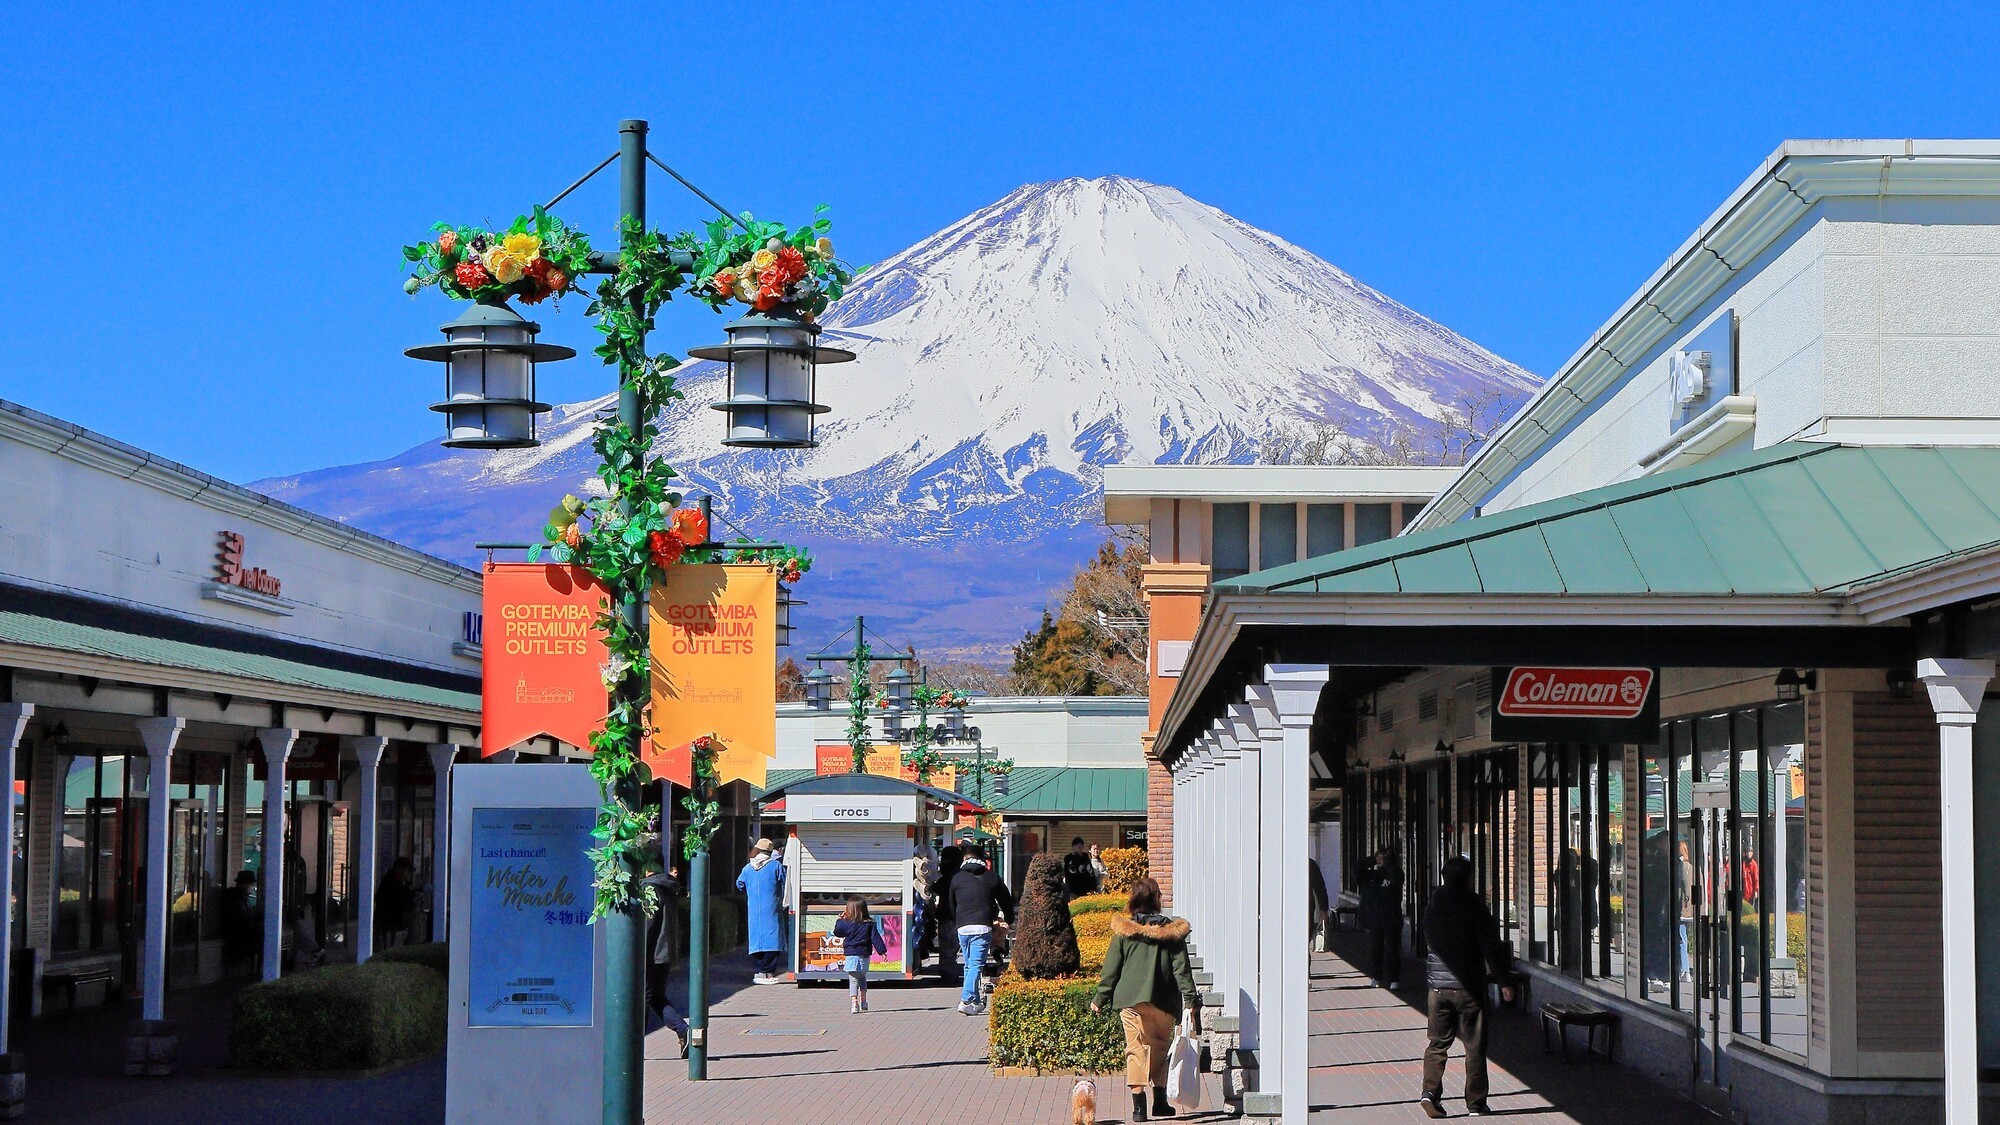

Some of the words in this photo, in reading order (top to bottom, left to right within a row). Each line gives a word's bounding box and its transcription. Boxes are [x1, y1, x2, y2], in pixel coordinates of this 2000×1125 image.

[501, 604, 591, 620] GOTEMBA
[668, 604, 757, 620] GOTEMBA
[505, 622, 588, 637] PREMIUM
[672, 622, 754, 637] PREMIUM
[505, 639, 587, 655] OUTLETS
[672, 639, 754, 655] OUTLETS
[1513, 672, 1618, 703] Coleman
[833, 806, 870, 817] crocs
[480, 847, 503, 858] Last
[504, 847, 546, 858] chance!!
[486, 864, 548, 889] Winter
[502, 875, 576, 913] Marche
